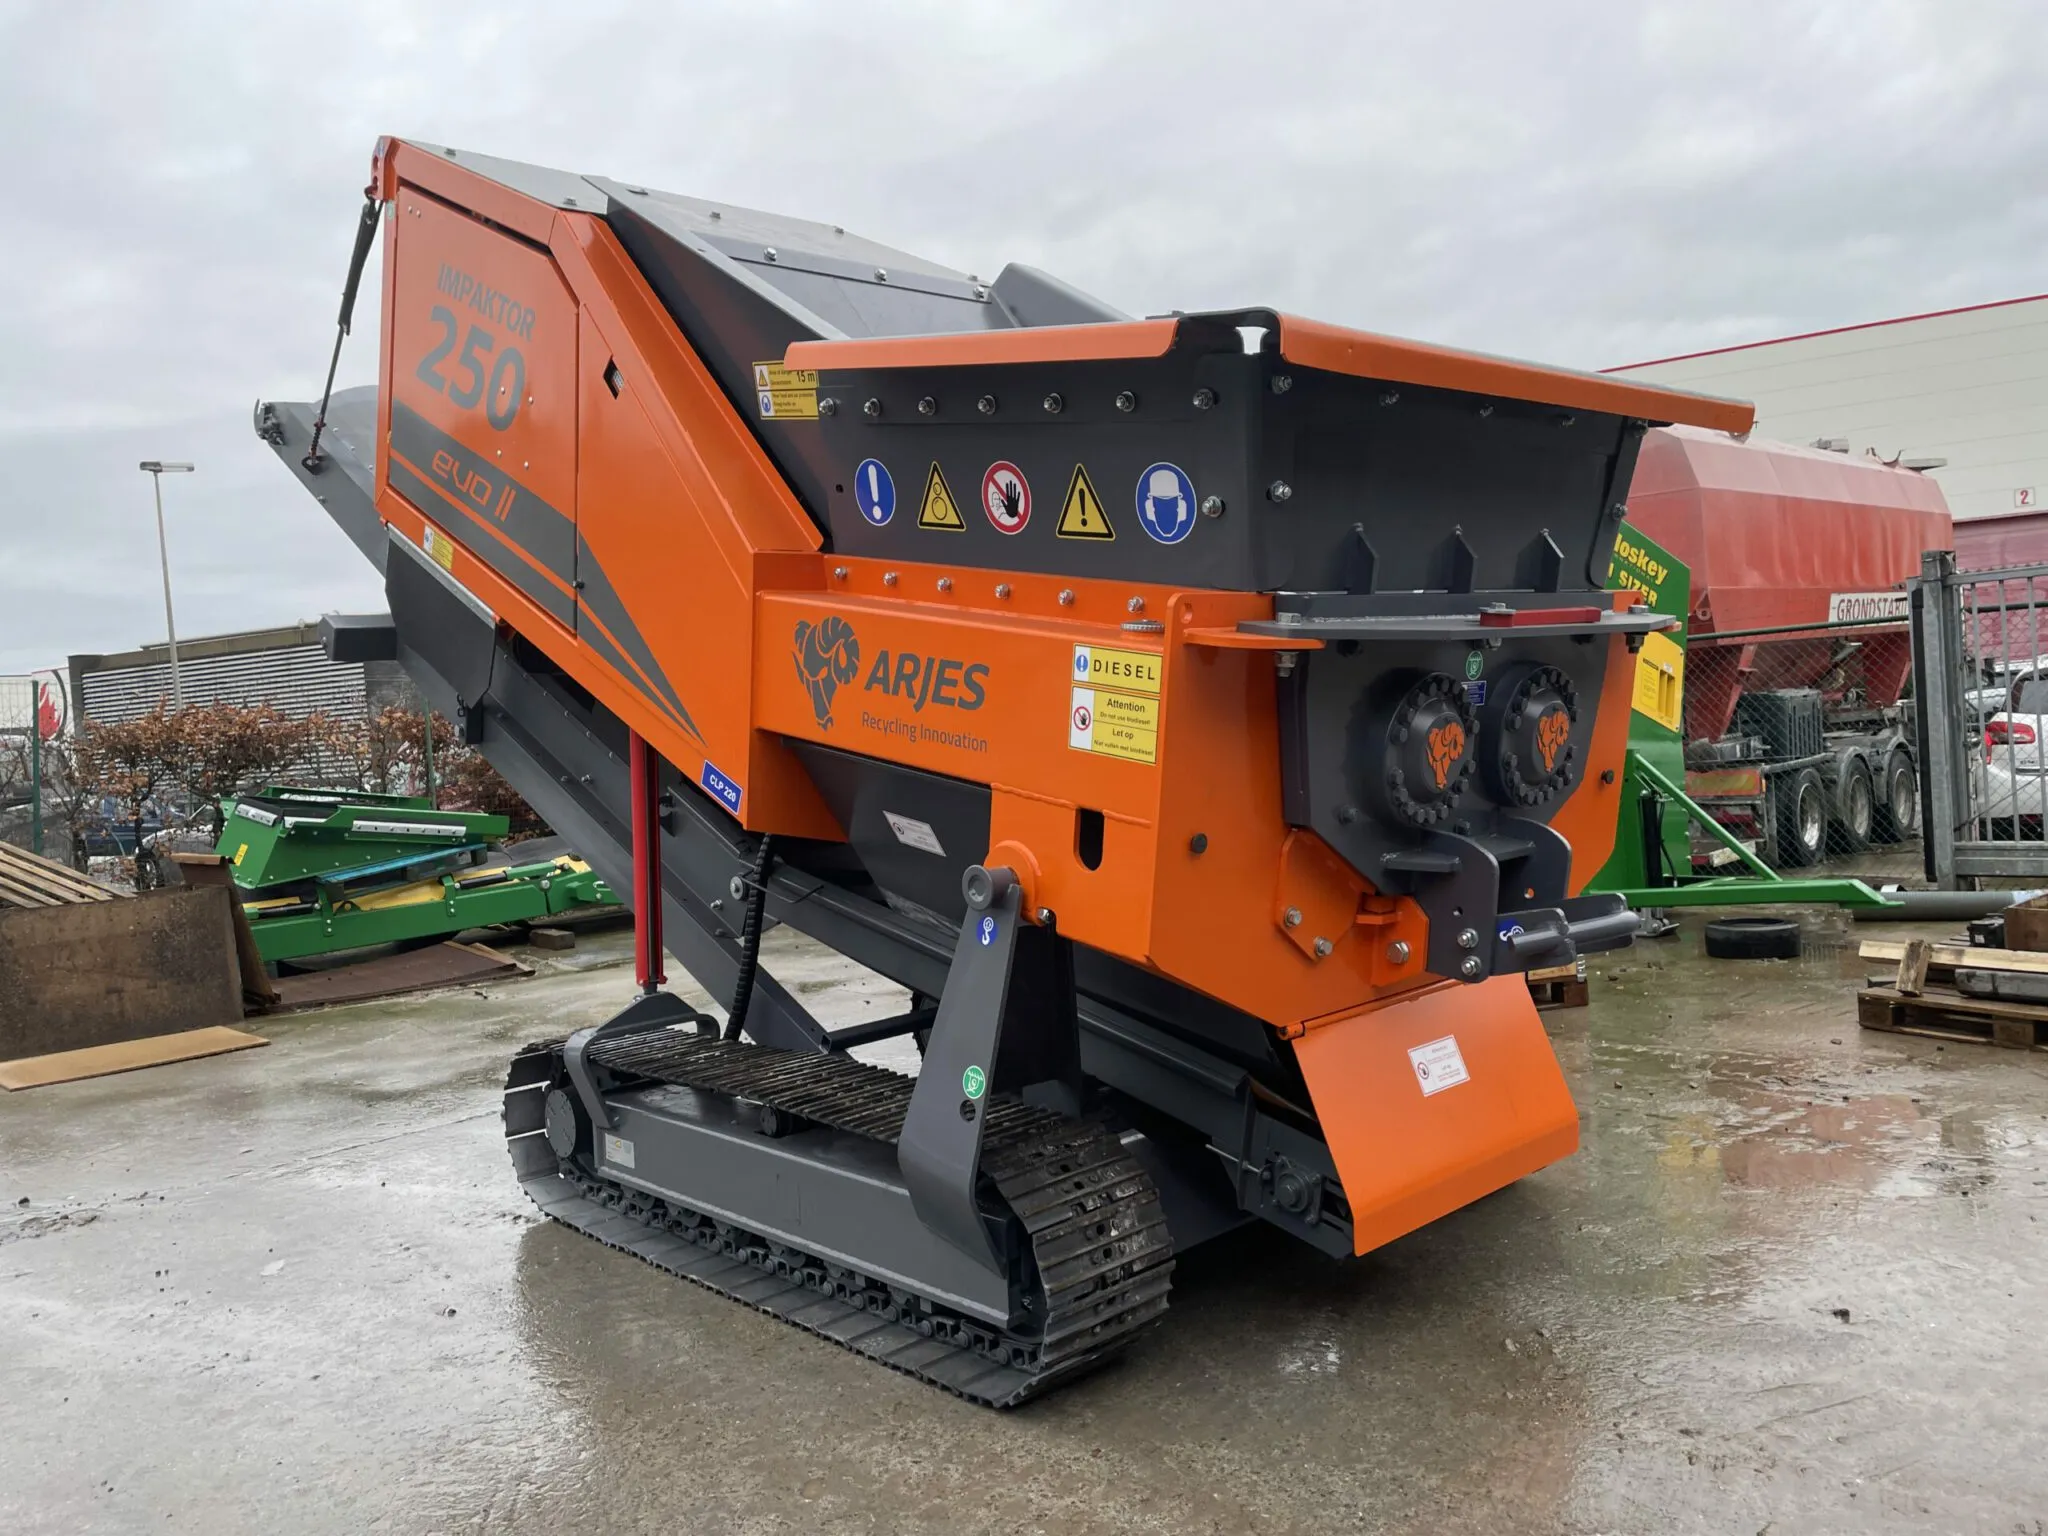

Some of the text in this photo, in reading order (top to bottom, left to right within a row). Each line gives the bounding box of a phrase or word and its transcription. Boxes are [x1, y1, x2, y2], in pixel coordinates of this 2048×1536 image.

[437, 262, 536, 342] IMPAKTOR
[415, 304, 526, 432] 250
[796, 370, 806, 383] 15
[807, 372, 816, 382] m
[432, 449, 492, 507] evo
[2020, 489, 2030, 505] 2
[1618, 570, 1659, 608] SIZER
[864, 649, 991, 713] ARJES
[1093, 659, 1155, 681] DIESEL
[1107, 698, 1145, 713] Attention
[861, 711, 989, 753] Recycling Innovation
[1112, 728, 1134, 740] Let op
[709, 774, 737, 803] CLP 220
